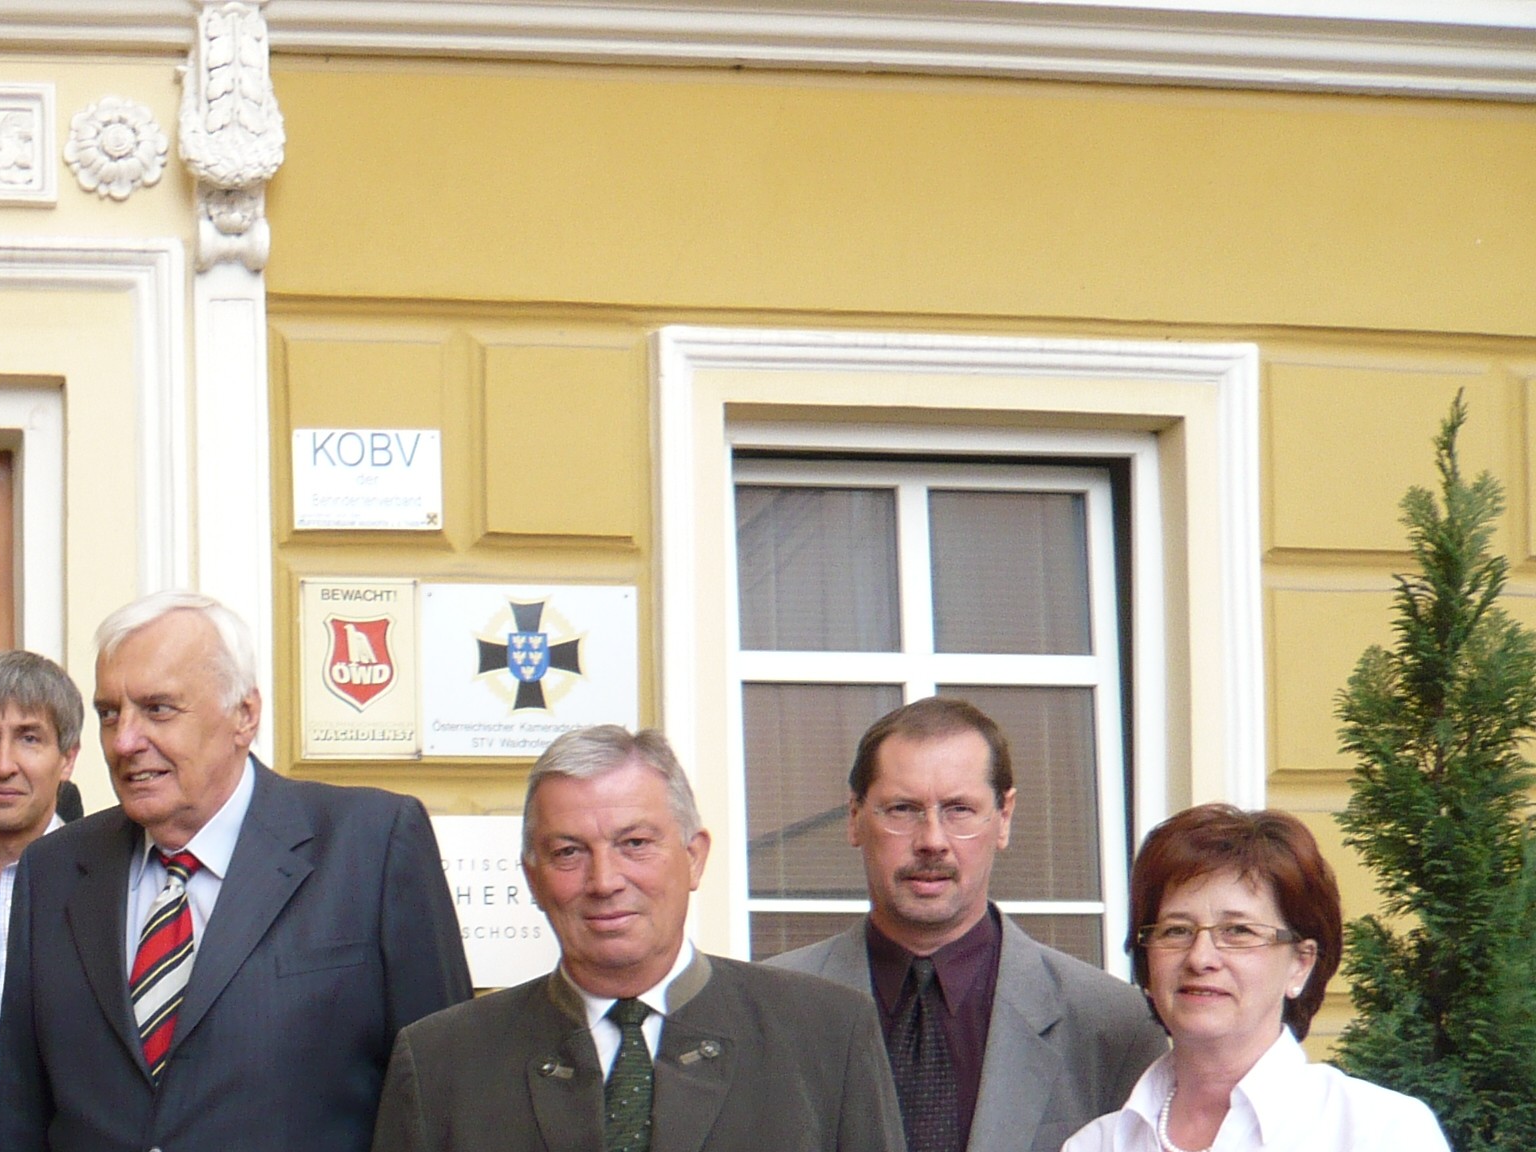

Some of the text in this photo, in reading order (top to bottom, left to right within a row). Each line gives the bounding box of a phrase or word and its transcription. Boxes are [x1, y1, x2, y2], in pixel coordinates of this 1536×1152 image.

[312, 431, 421, 467] KOBV
[320, 588, 397, 602] BEWACHT!
[331, 661, 391, 685] ÖWD
[431, 719, 515, 733] Österreichischer
[312, 728, 415, 742] WACHDIENST
[471, 737, 495, 748] STV
